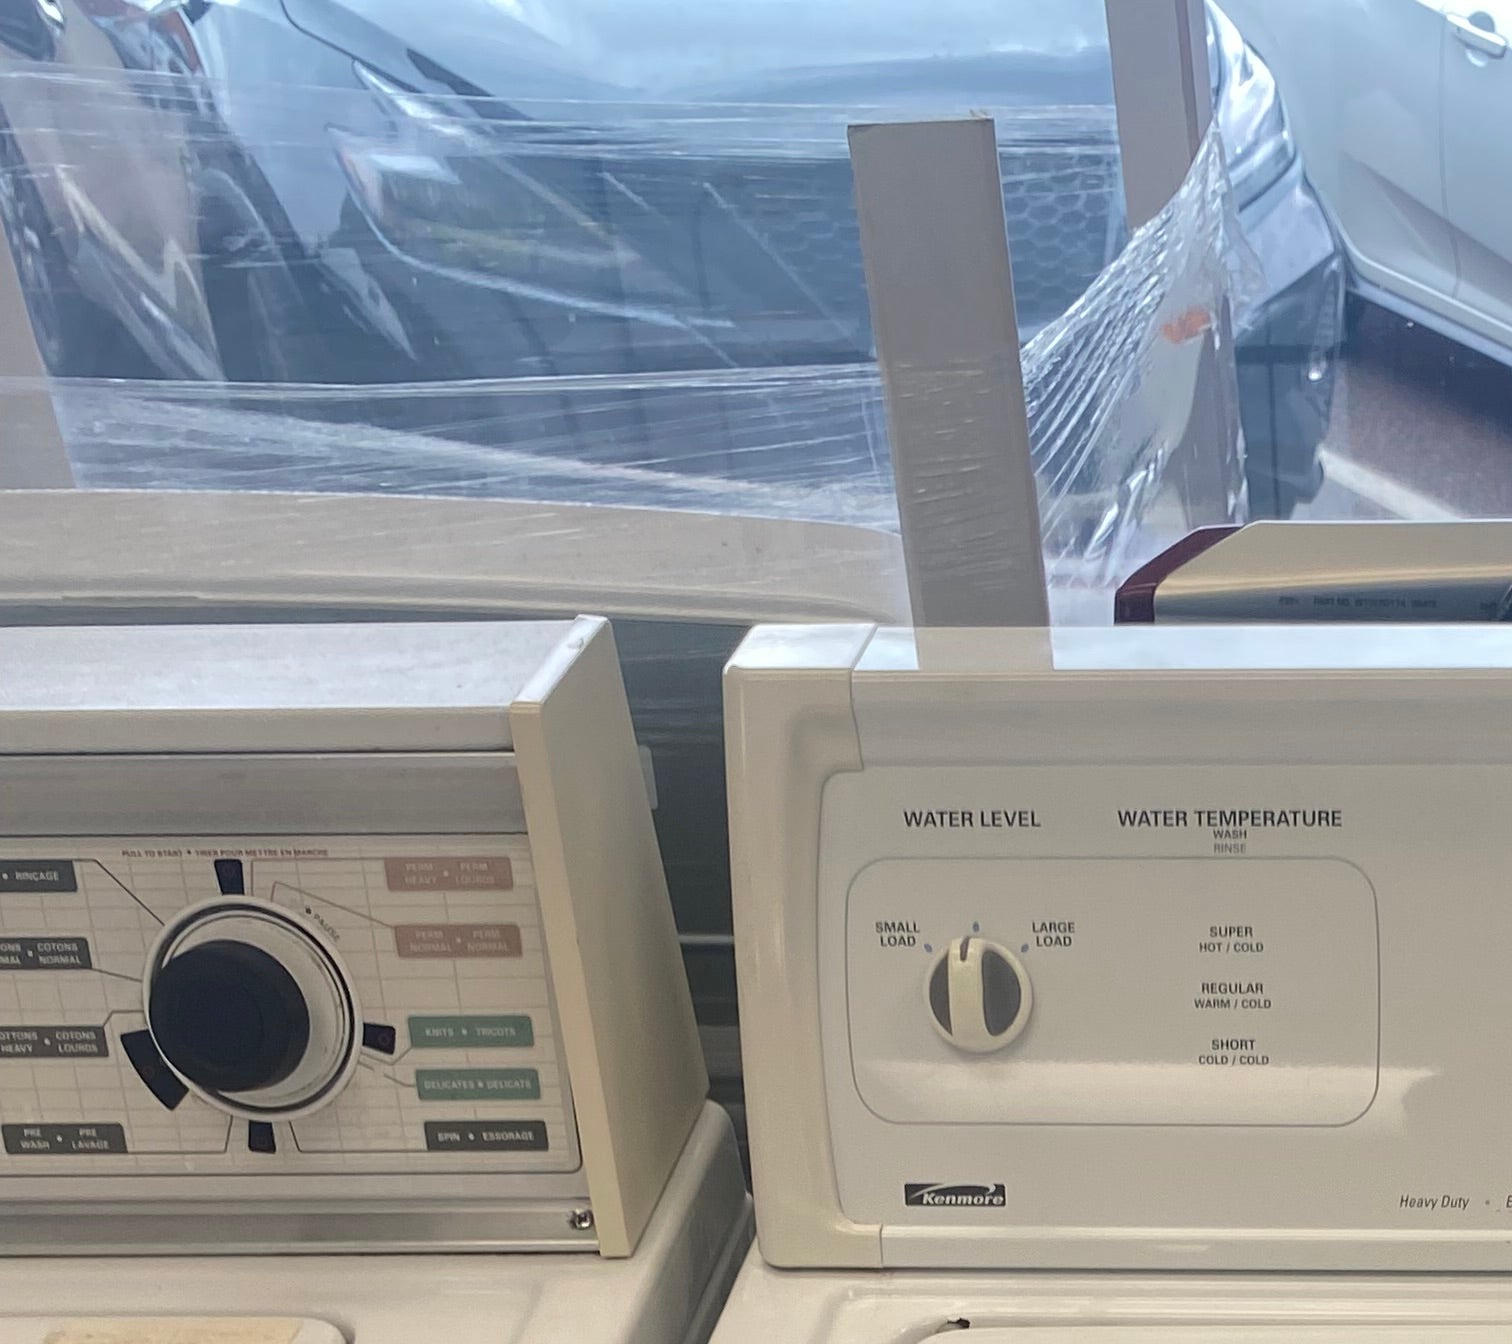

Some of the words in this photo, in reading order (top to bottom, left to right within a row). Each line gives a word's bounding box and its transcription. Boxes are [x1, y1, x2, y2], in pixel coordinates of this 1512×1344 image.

[904, 810, 974, 827] WATER
[980, 811, 1041, 827] LEVEL
[1118, 810, 1188, 827] WATER
[1193, 810, 1342, 827] TEMPERATURE
[1213, 829, 1247, 839] WASH
[1213, 843, 1246, 854] RINSE
[875, 922, 920, 933] SMALL
[1032, 922, 1075, 933] LARGE
[1209, 926, 1253, 938] SUPER
[880, 936, 916, 947] LOAD
[1036, 936, 1072, 947] LOAD
[1199, 942, 1222, 953] HOT
[1233, 942, 1264, 953] COLD
[1201, 982, 1264, 994] REGULAR
[1194, 998, 1231, 1009] WARM
[1241, 999, 1272, 1009] COLD
[1211, 1039, 1256, 1051] SHORT
[1198, 1055, 1229, 1065] COLD
[1239, 1055, 1270, 1065] COLD
[1399, 1195, 1438, 1211] Heavy
[1440, 1195, 1470, 1211] Duty
